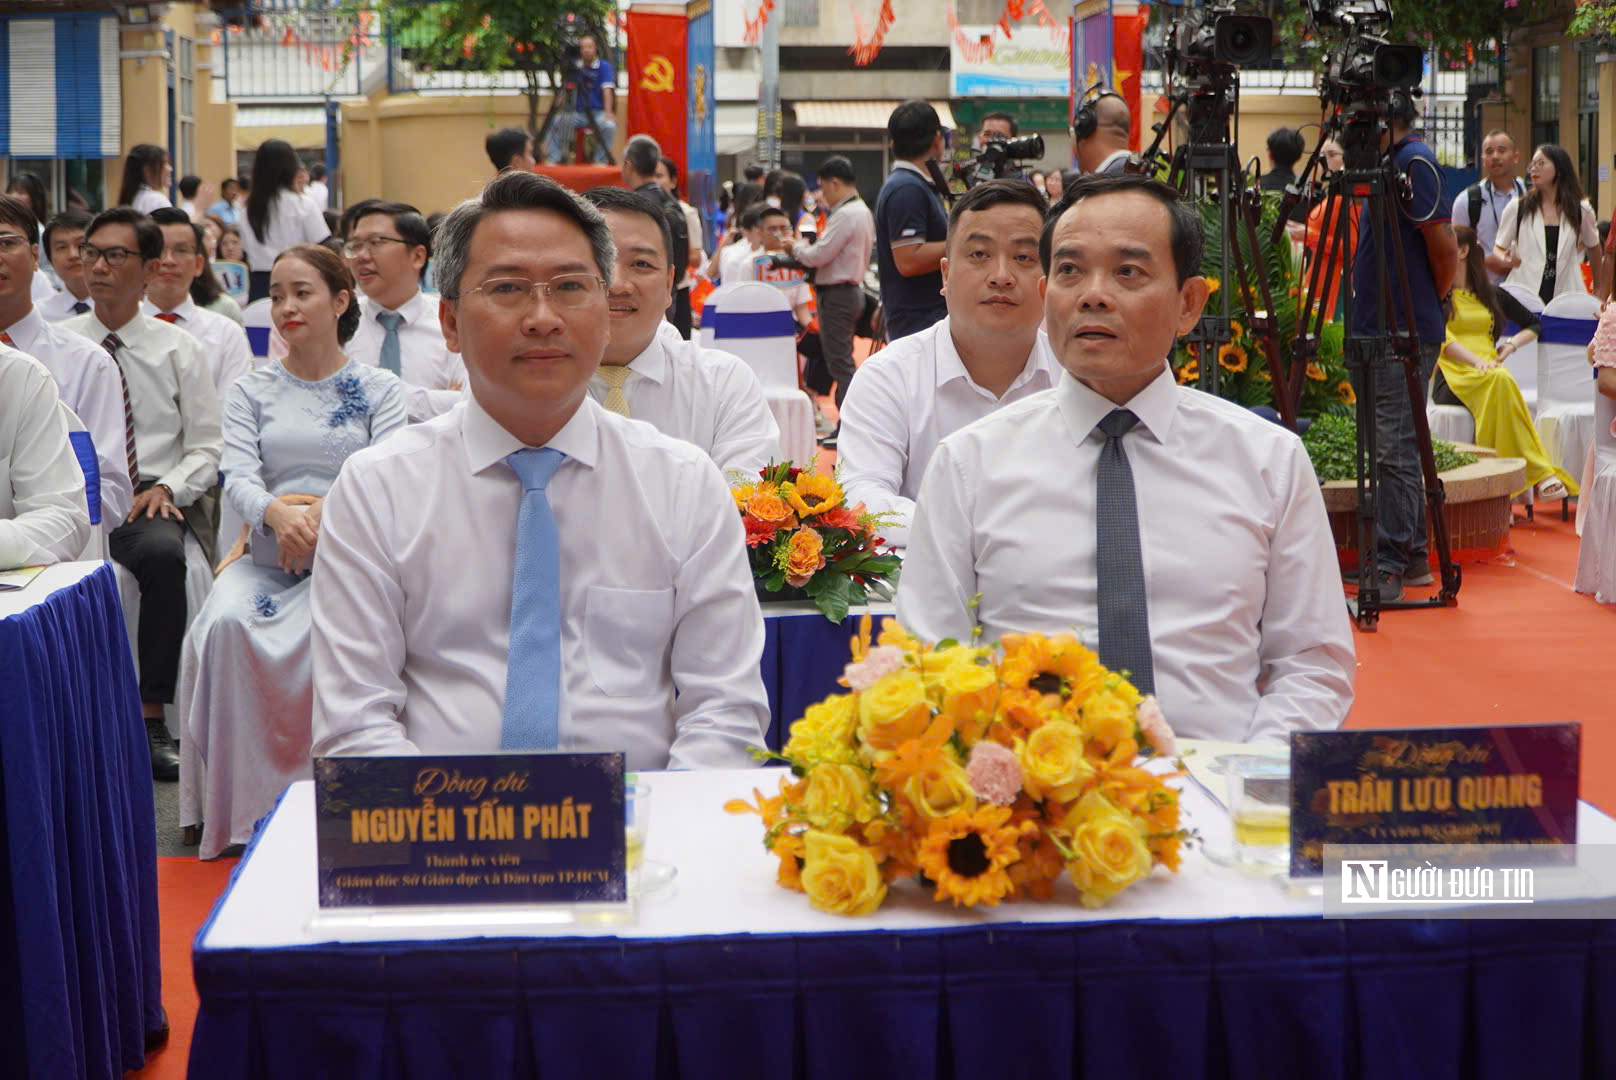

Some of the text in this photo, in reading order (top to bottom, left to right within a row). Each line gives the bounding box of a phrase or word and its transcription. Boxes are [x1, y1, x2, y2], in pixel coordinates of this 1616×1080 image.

[494, 770, 530, 793] chí
[1327, 772, 1543, 814] TRẦN LƯU QUANG
[351, 797, 592, 843] NGUYỄN TẤN PHÁT
[490, 852, 521, 866] viên
